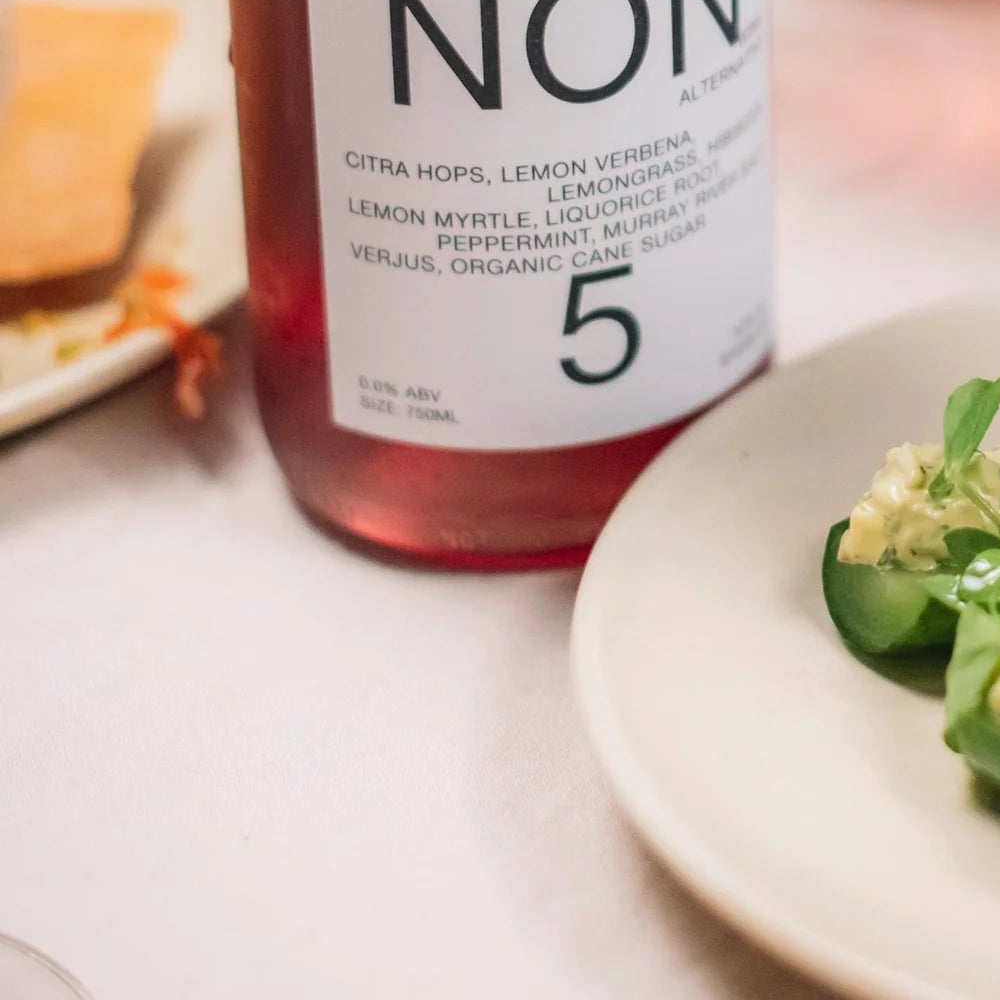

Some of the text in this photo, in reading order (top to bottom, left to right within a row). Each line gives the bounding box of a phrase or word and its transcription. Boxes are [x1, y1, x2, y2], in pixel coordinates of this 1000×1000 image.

[346, 150, 409, 178] CITRA
[417, 163, 491, 186] HOPS,
[501, 159, 587, 183] LEMON
[348, 196, 425, 226] LEMON
[434, 211, 539, 230] MYRTLE,
[546, 185, 666, 226] LIQUORICE
[674, 159, 719, 196] ROOT
[350, 213, 706, 277] VERJUS, ORGANIC CANE SUGAR
[438, 226, 595, 252] PEPPERMINT,
[603, 199, 688, 241] MURRAY
[560, 263, 640, 386] 5
[406, 386, 441, 402] ABV
[406, 403, 460, 423] 750ML
